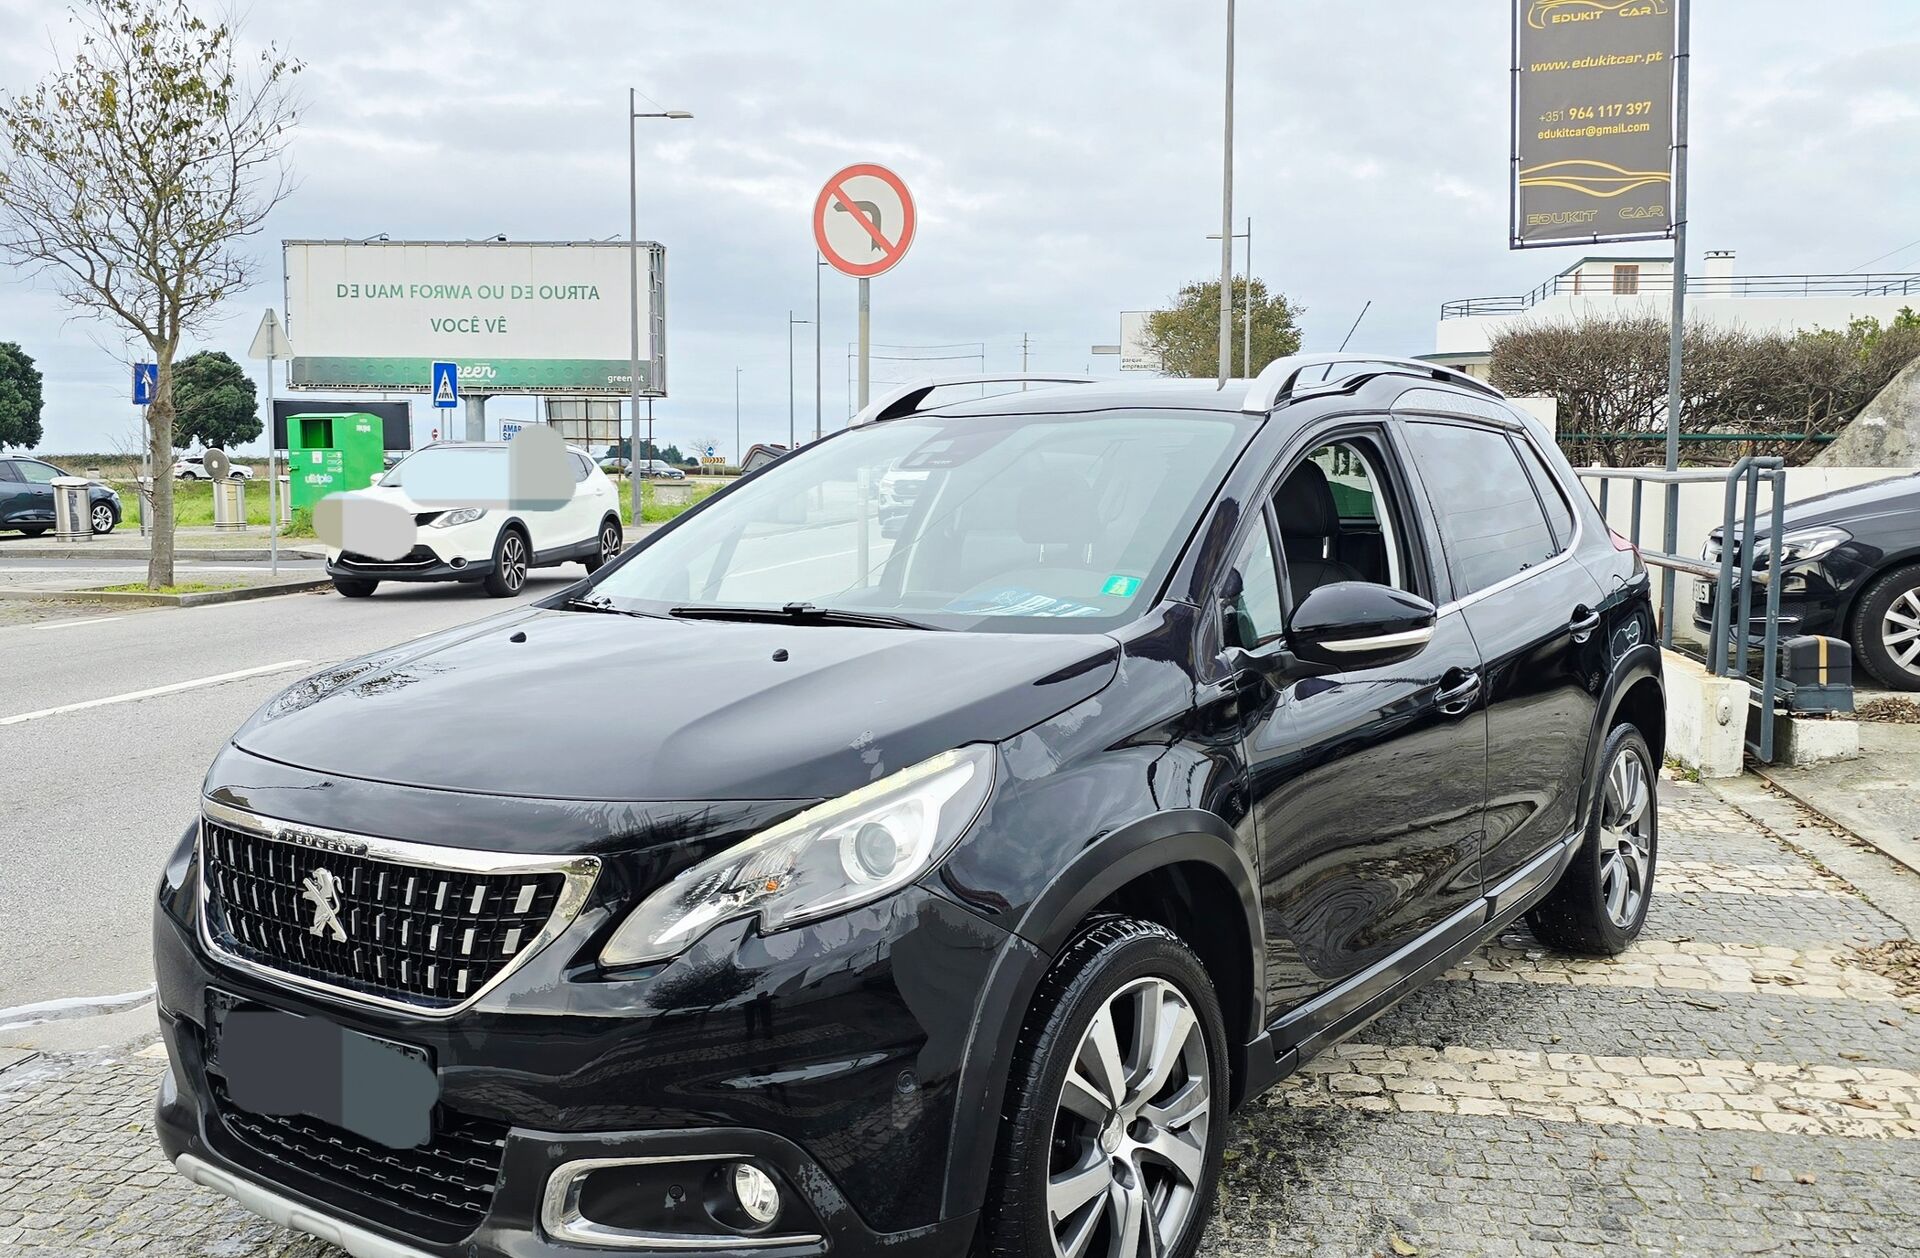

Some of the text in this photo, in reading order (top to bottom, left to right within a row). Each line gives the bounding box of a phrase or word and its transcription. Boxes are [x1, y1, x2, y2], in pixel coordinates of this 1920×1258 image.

[1552, 7, 1651, 23] EDUKIT CAR
[1531, 51, 1663, 72] www.edukitcar.pt
[1539, 102, 1651, 122] +351 964 117 397
[1538, 123, 1649, 139] edukitcar@gmail.com
[1526, 206, 1664, 225] EDUKIT CAR
[478, 285, 504, 299] OU
[430, 315, 507, 333] VOCÊ VÊ
[285, 832, 358, 854] PEUGEOT
